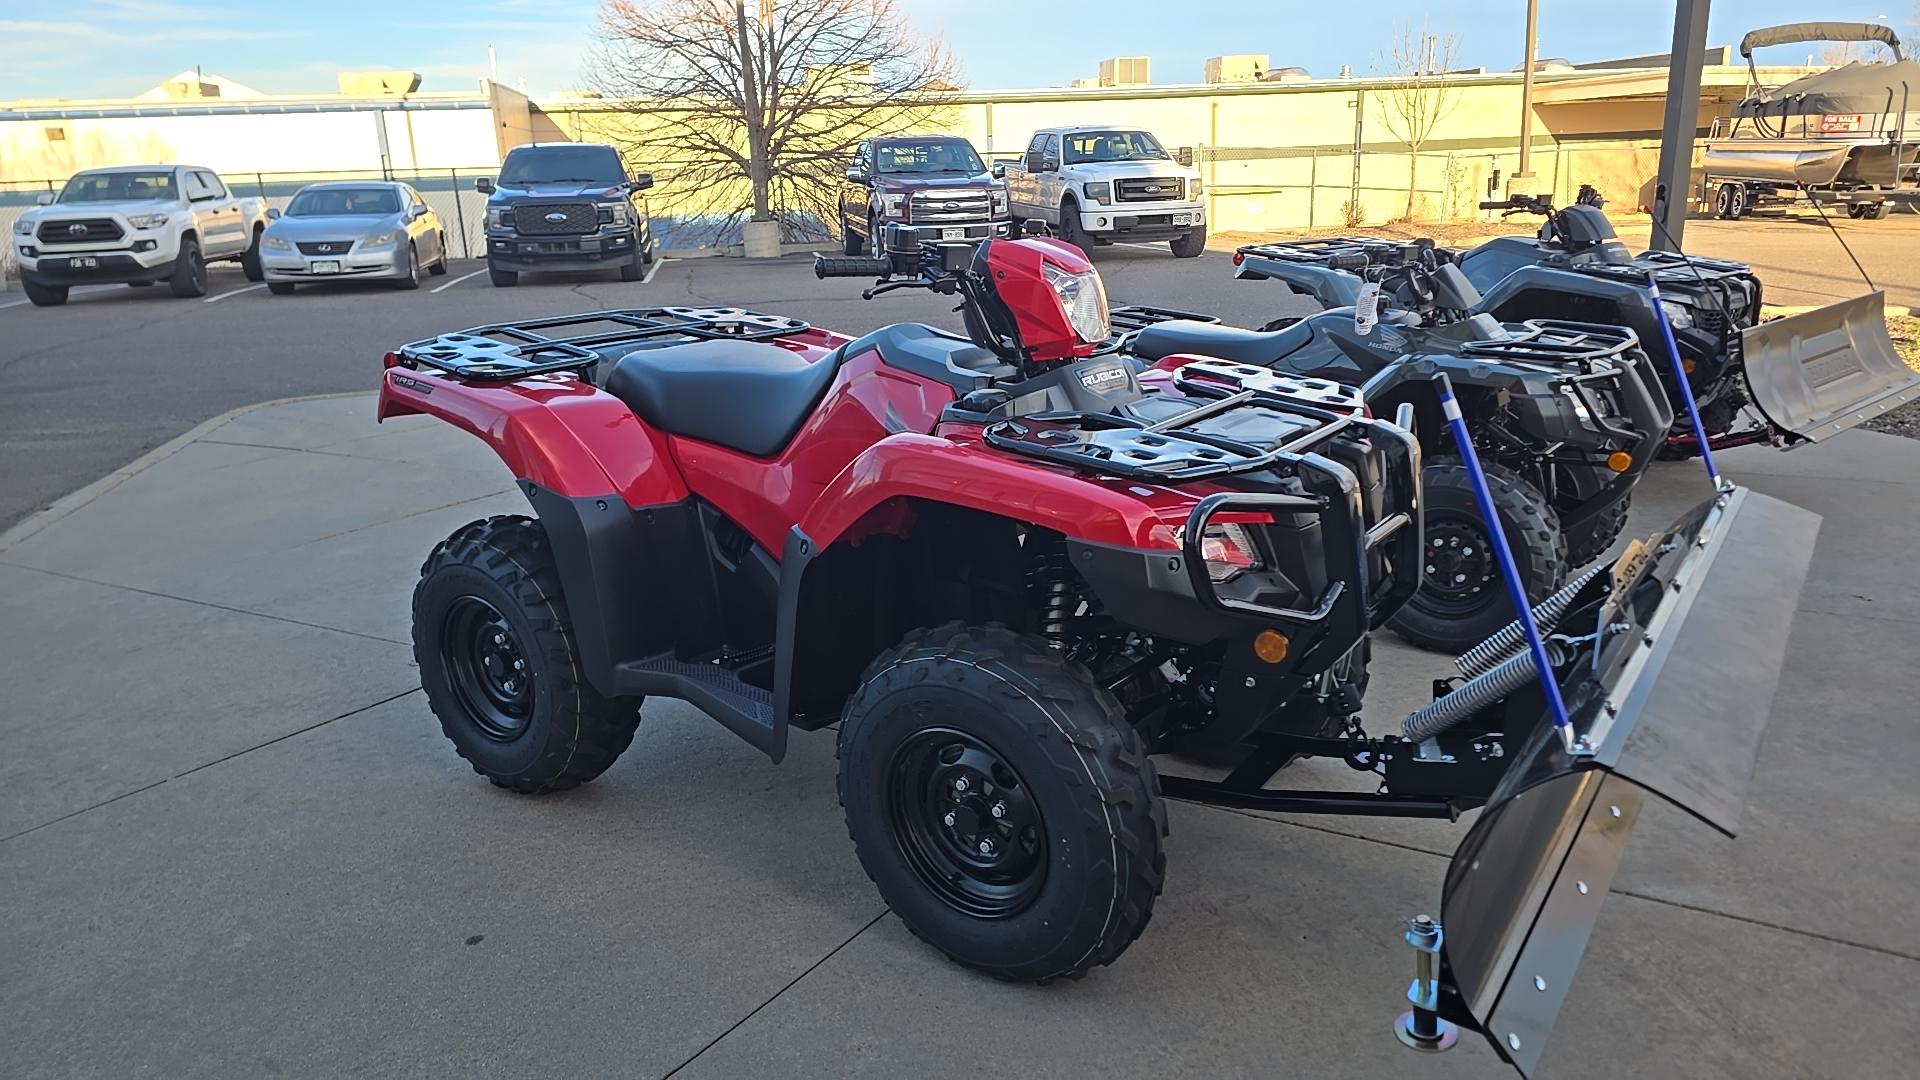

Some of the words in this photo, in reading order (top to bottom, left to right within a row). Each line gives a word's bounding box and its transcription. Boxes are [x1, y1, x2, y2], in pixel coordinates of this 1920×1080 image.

[1838, 115, 1859, 123] SALE
[1367, 341, 1403, 354] HONDA
[395, 375, 415, 386] IRS
